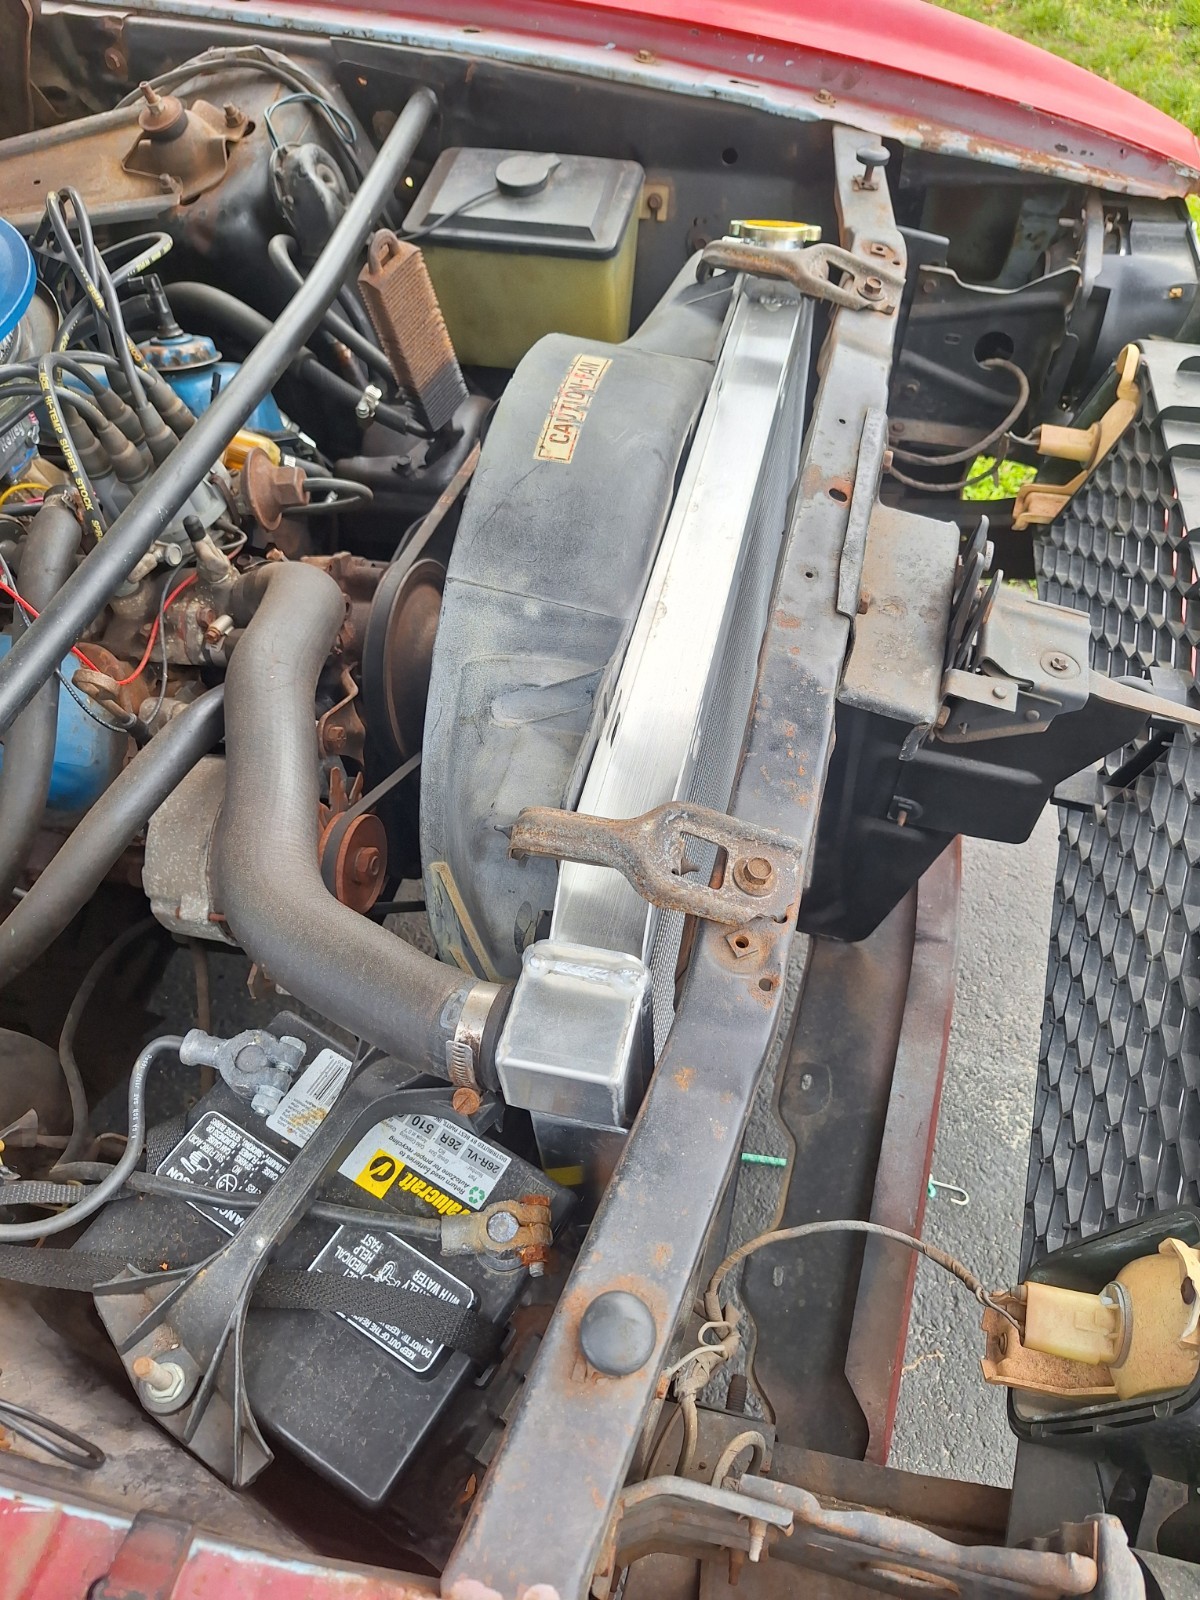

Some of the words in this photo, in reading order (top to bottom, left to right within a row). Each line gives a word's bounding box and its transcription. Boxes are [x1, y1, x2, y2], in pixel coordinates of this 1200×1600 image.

[44, 395, 63, 434] HI-TEMP
[59, 439, 78, 473] SUPER
[76, 478, 94, 511] STOCK
[206, 1124, 215, 1134] OR
[210, 1118, 227, 1132] BURNS
[412, 1116, 434, 1134] 510
[188, 1133, 203, 1146] ACID
[206, 1134, 222, 1148] CAUSE
[212, 1129, 237, 1149] BLINDNESS
[224, 1127, 242, 1142] SEVERE
[440, 1133, 462, 1150] 26R
[457, 1130, 470, 1140] BEST
[199, 1140, 226, 1163] SULFURIC
[218, 1142, 231, 1155] CAN
[242, 1138, 264, 1158] SMOKING
[388, 1135, 414, 1153] recycling
[477, 1142, 507, 1162] DISTRIBUTED
[234, 1154, 253, 1170] SPARKS
[239, 1148, 259, 1164] FLAMES
[413, 1152, 433, 1165] proper
[467, 1148, 500, 1174] 26R-VL
[232, 1165, 243, 1175] NO
[406, 1155, 431, 1174] batteries
[262, 1166, 278, 1180] CAUSE
[430, 1170, 445, 1181] used
[441, 1169, 470, 1188] AutoZone
[445, 1179, 465, 1195] Return
[360, 1234, 383, 1253] FAST
[335, 1245, 368, 1275] MEDICAL
[353, 1246, 376, 1264] HELP
[412, 1270, 441, 1294] WATER
[438, 1288, 460, 1305] WITH
[369, 1323, 382, 1336] THE
[379, 1332, 390, 1341] OF
[387, 1337, 401, 1349] OUT
[409, 1340, 424, 1352] NOT
[399, 1346, 416, 1360] KEEP
[421, 1348, 432, 1358] DO
